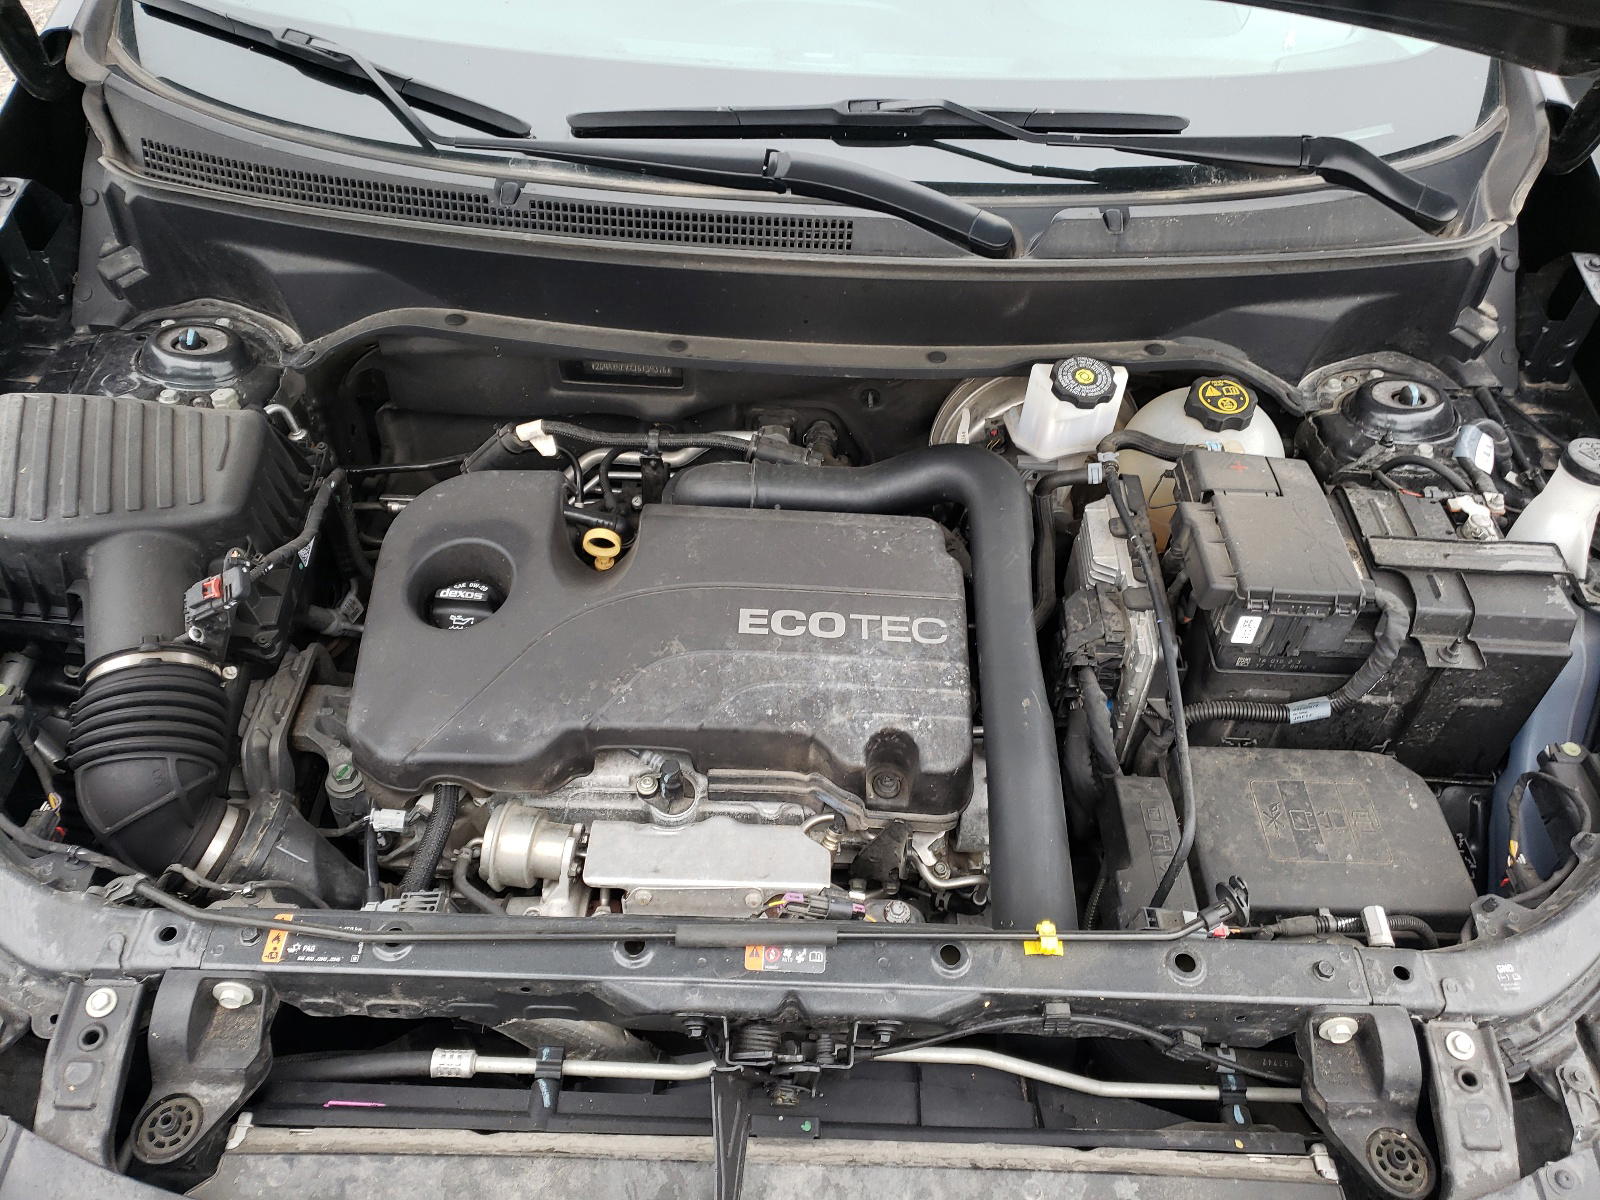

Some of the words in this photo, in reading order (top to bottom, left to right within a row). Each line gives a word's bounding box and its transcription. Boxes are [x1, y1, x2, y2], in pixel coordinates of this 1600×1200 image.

[439, 587, 484, 600] dexos
[738, 608, 948, 644] ECOTEC
[302, 944, 316, 953] PAG
